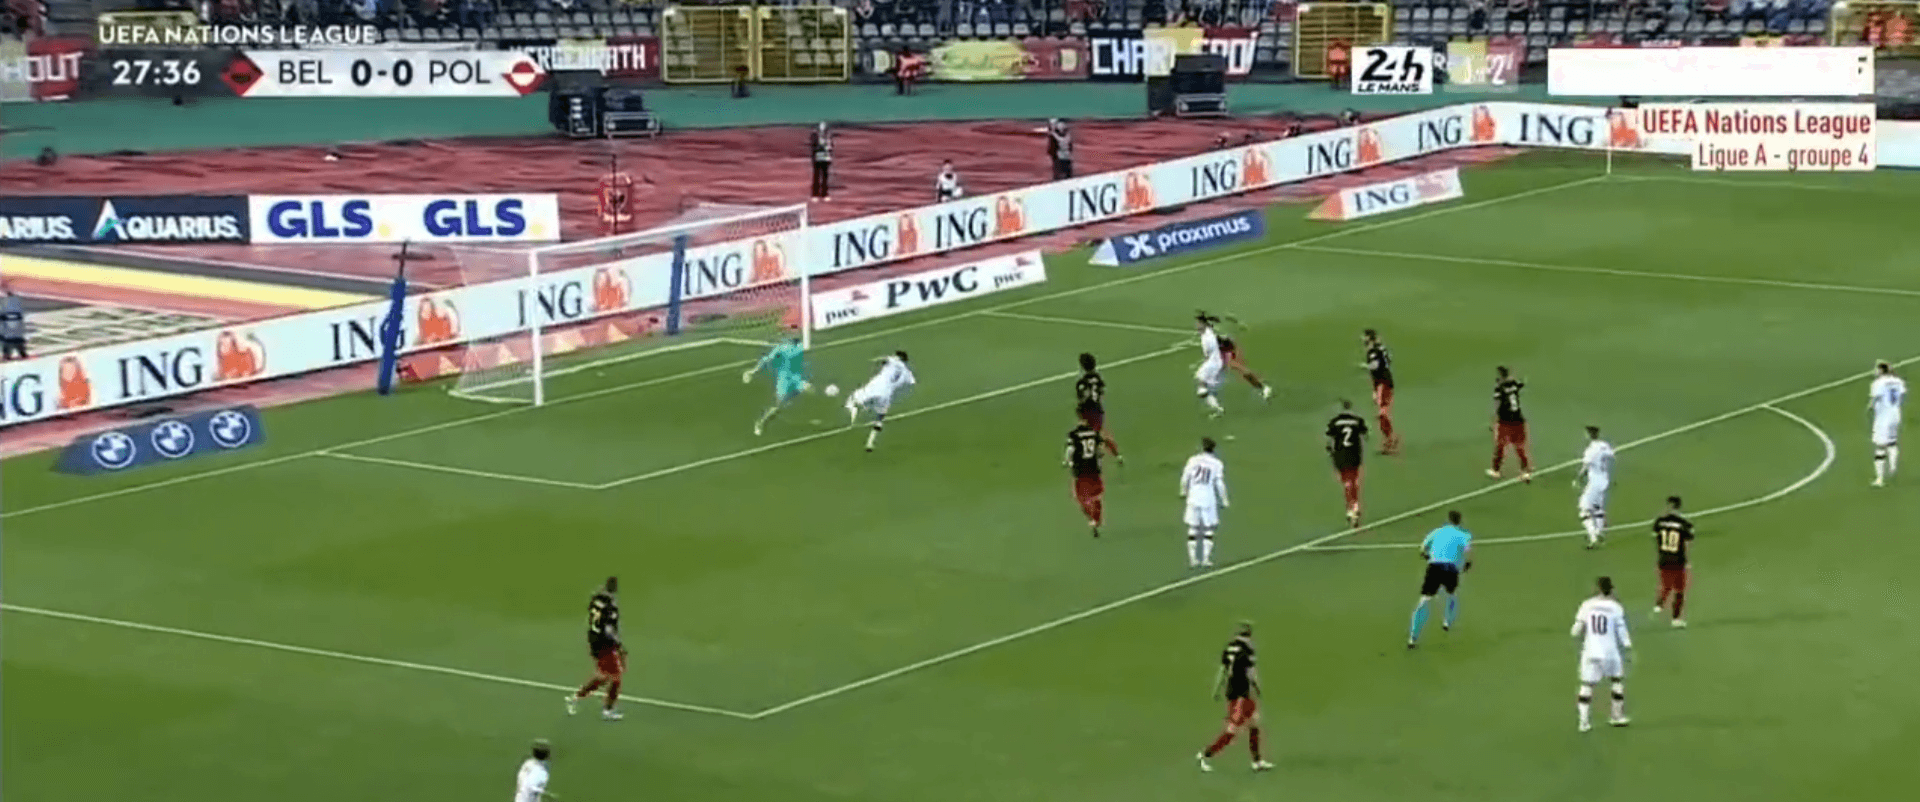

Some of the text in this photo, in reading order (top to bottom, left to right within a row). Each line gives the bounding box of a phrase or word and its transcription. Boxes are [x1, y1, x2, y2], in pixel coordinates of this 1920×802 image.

[1418, 116, 1463, 152] ING
[1520, 113, 1595, 146] ING
[1306, 138, 1352, 175] ING
[1192, 159, 1238, 197] ING
[1068, 183, 1118, 222] ING
[1353, 184, 1411, 212] ING
[832, 225, 890, 268] ING
[935, 207, 988, 249] ING
[1157, 216, 1251, 252] proximus
[684, 252, 744, 296] ING
[518, 281, 583, 327] ING
[117, 347, 203, 399] ING
[1342, 426, 1354, 447] 2
[1591, 613, 1608, 636] 10
